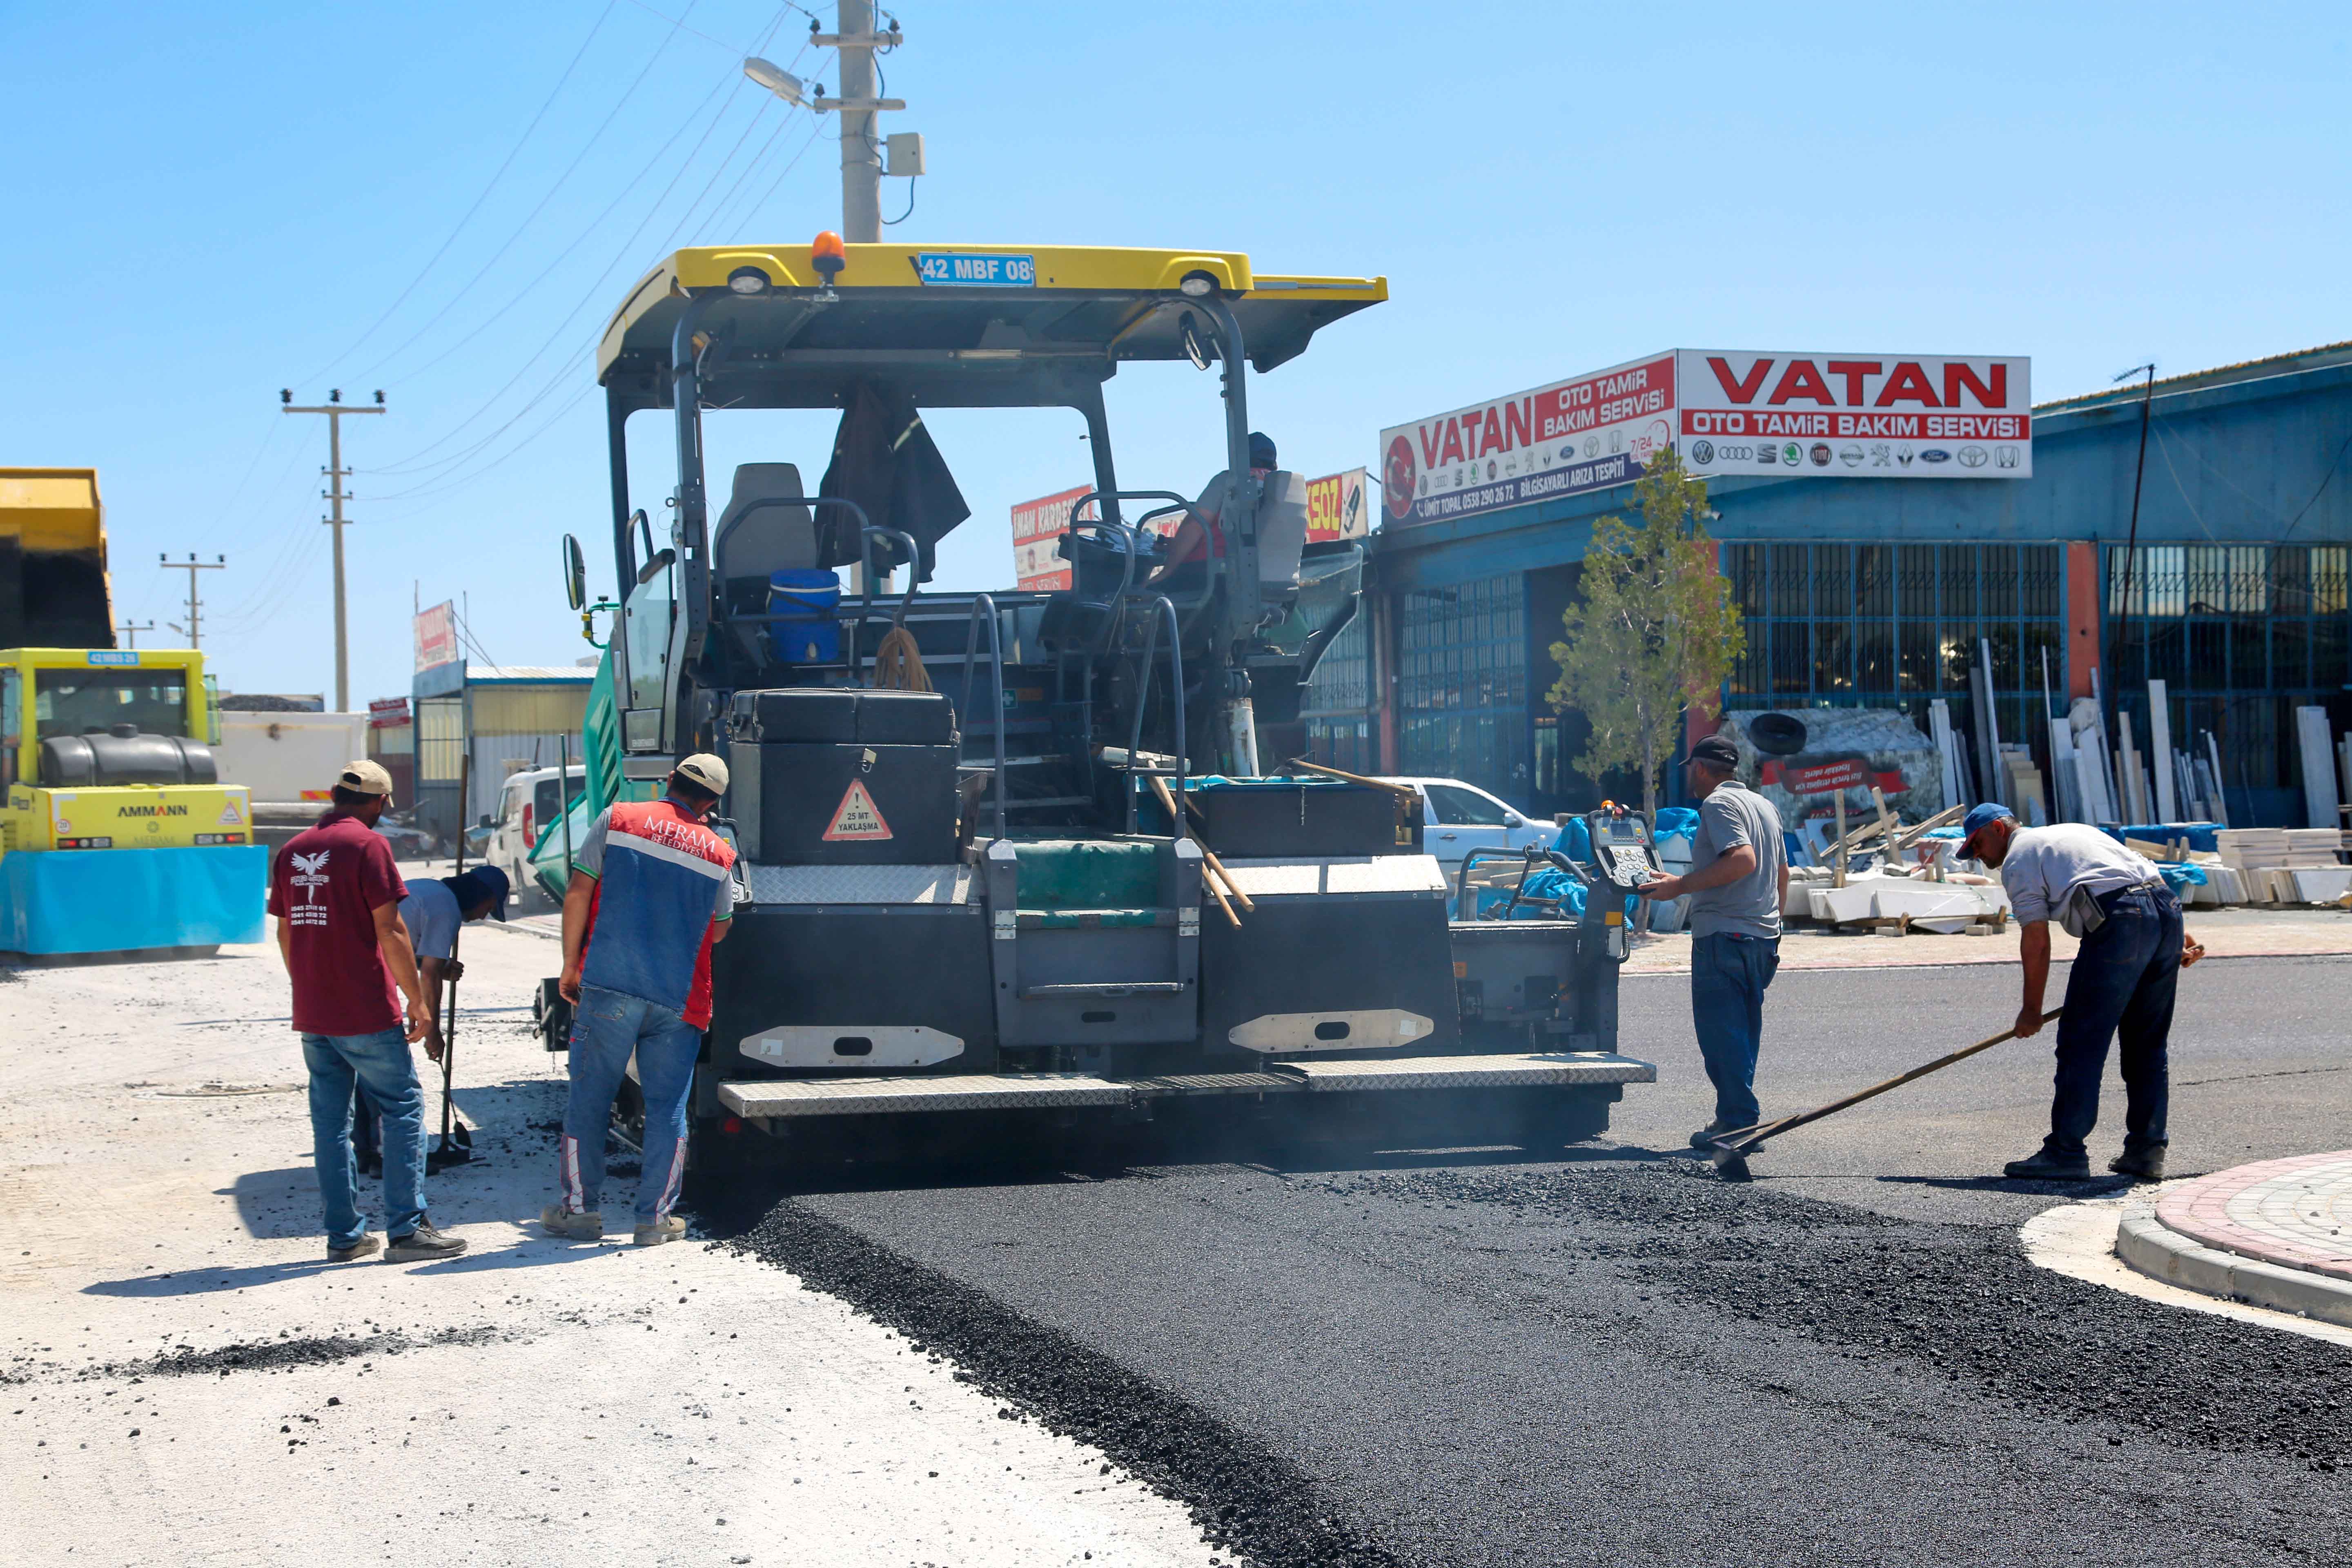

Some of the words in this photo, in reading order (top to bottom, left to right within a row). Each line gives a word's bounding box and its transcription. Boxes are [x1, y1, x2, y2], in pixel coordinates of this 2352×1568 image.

[923, 258, 949, 278] 42
[954, 259, 999, 279] MBF
[1006, 261, 1031, 281] 08
[1706, 356, 2007, 408] VATAN
[1558, 384, 1592, 410] OTO
[1419, 396, 1531, 470] VATAN
[1544, 407, 1595, 437] BAKIM
[1693, 412, 1745, 433] OTO
[1838, 415, 1918, 436] BAKIM
[1630, 436, 1652, 452] 7/24
[1570, 466, 1594, 487] ARIZA
[1595, 456, 1625, 482] TESPİTİ
[1441, 495, 1462, 514] TOPAL
[1463, 492, 1480, 510] 0538
[1481, 488, 1494, 506] 290
[1495, 486, 1504, 503] 26
[1506, 484, 1514, 501] 72
[118, 805, 187, 817] AMMANN
[858, 812, 869, 820] MT
[644, 815, 716, 853] MERAM
[838, 822, 878, 832] YAKLAŞMA
